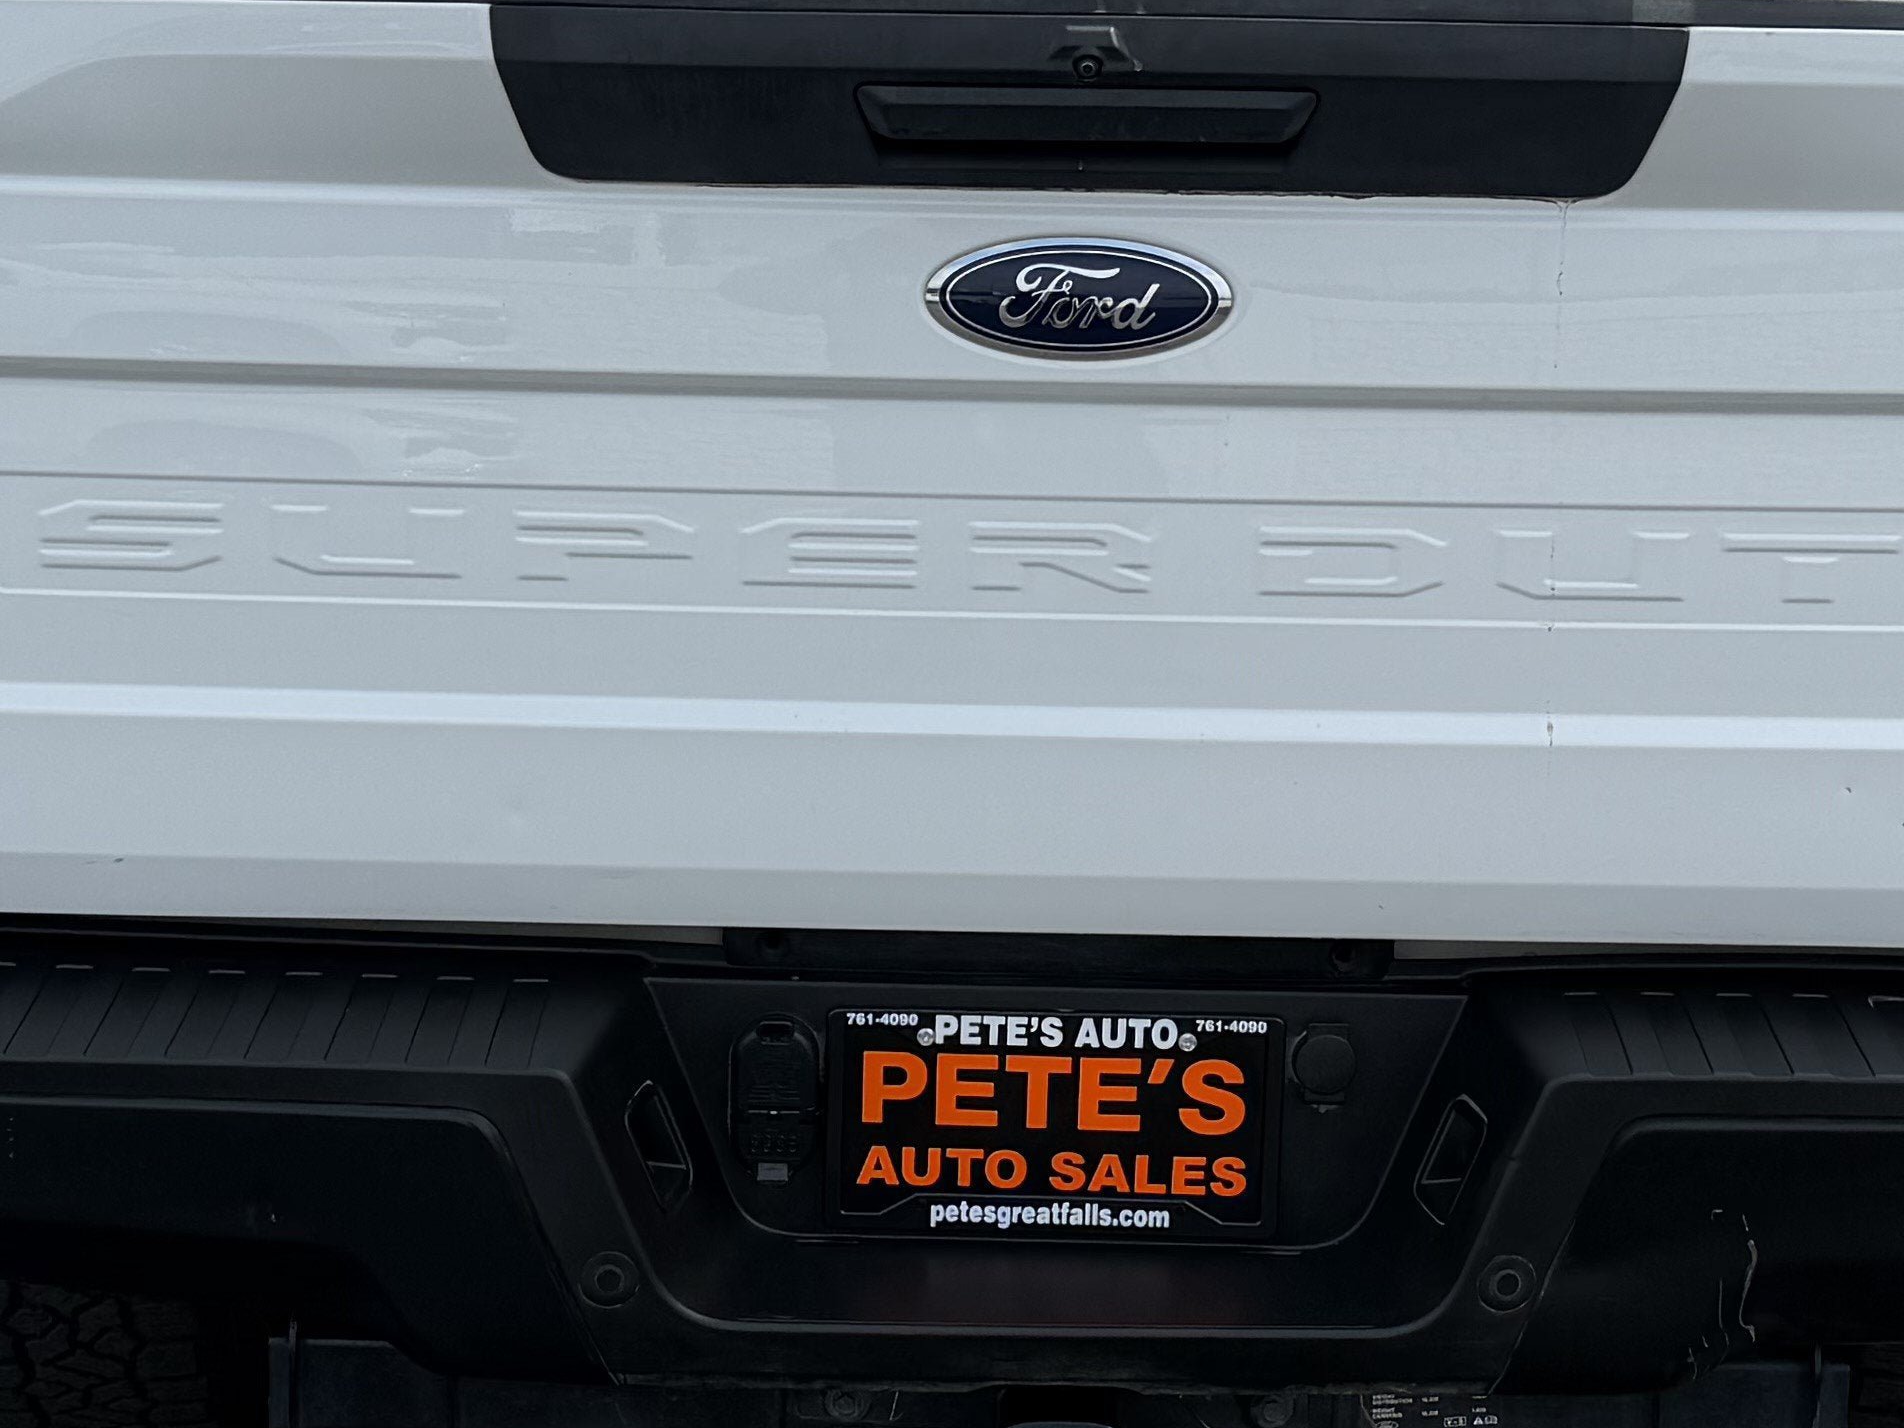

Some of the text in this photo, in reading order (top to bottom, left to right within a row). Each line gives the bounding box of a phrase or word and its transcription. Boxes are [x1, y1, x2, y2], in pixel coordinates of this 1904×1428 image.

[998, 263, 1160, 330] Ford
[38, 498, 1152, 594] SUPER
[846, 1012, 919, 1027] 761-4090
[934, 1014, 1179, 1050] PETE'S AUTO
[1195, 1019, 1268, 1034] 761-4090
[861, 1050, 1246, 1136] PETE'S
[856, 1145, 1247, 1197] AUTO SALES
[930, 1200, 1170, 1229] petesgreatfalls.com
